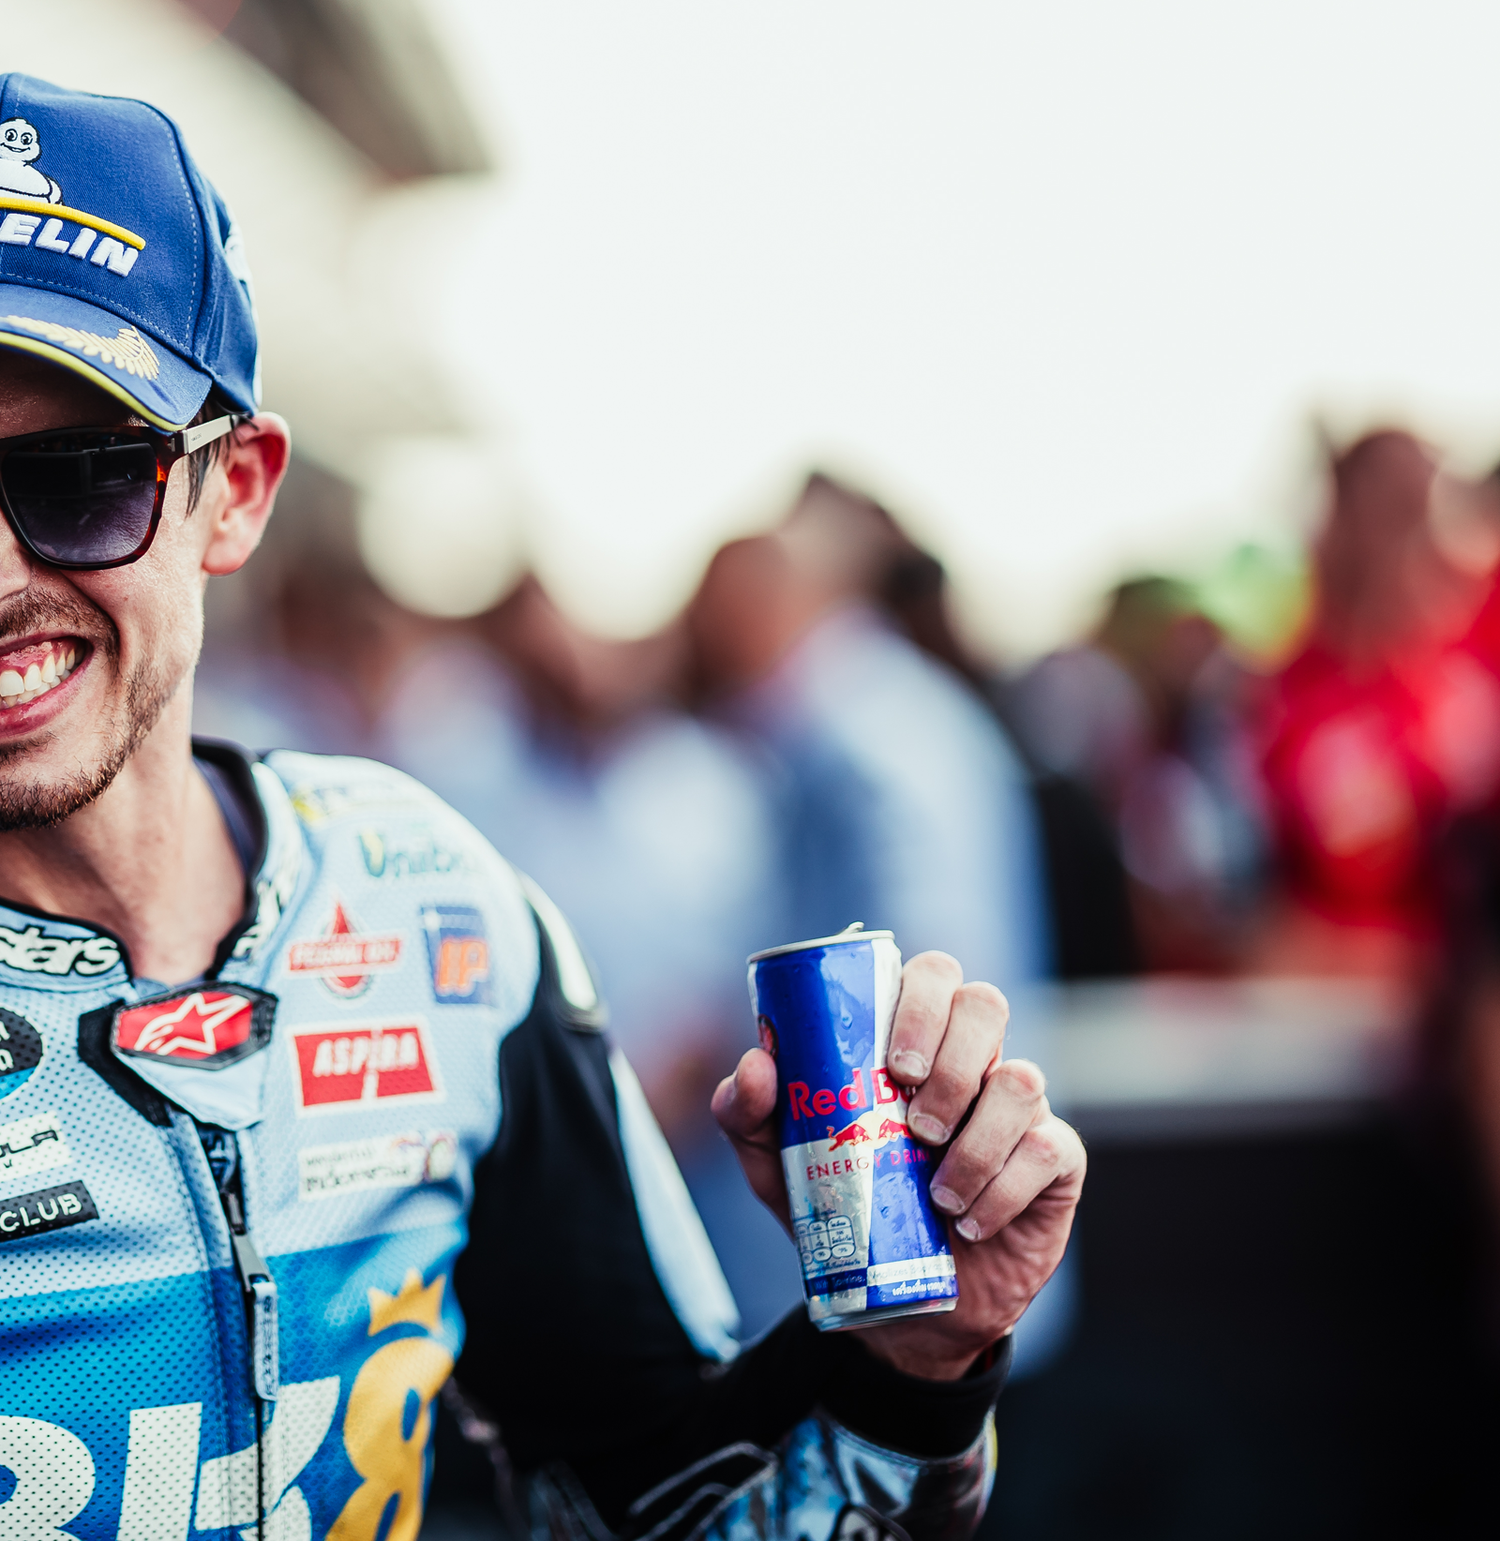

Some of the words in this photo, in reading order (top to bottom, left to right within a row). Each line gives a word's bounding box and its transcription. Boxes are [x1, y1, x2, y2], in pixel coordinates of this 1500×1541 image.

[312, 1031, 420, 1078] ASPIRA
[787, 1066, 868, 1121] Red
[805, 1153, 882, 1181] ENERGY
[890, 1148, 931, 1167] DRIN
[0, 1193, 83, 1233] CLUB
